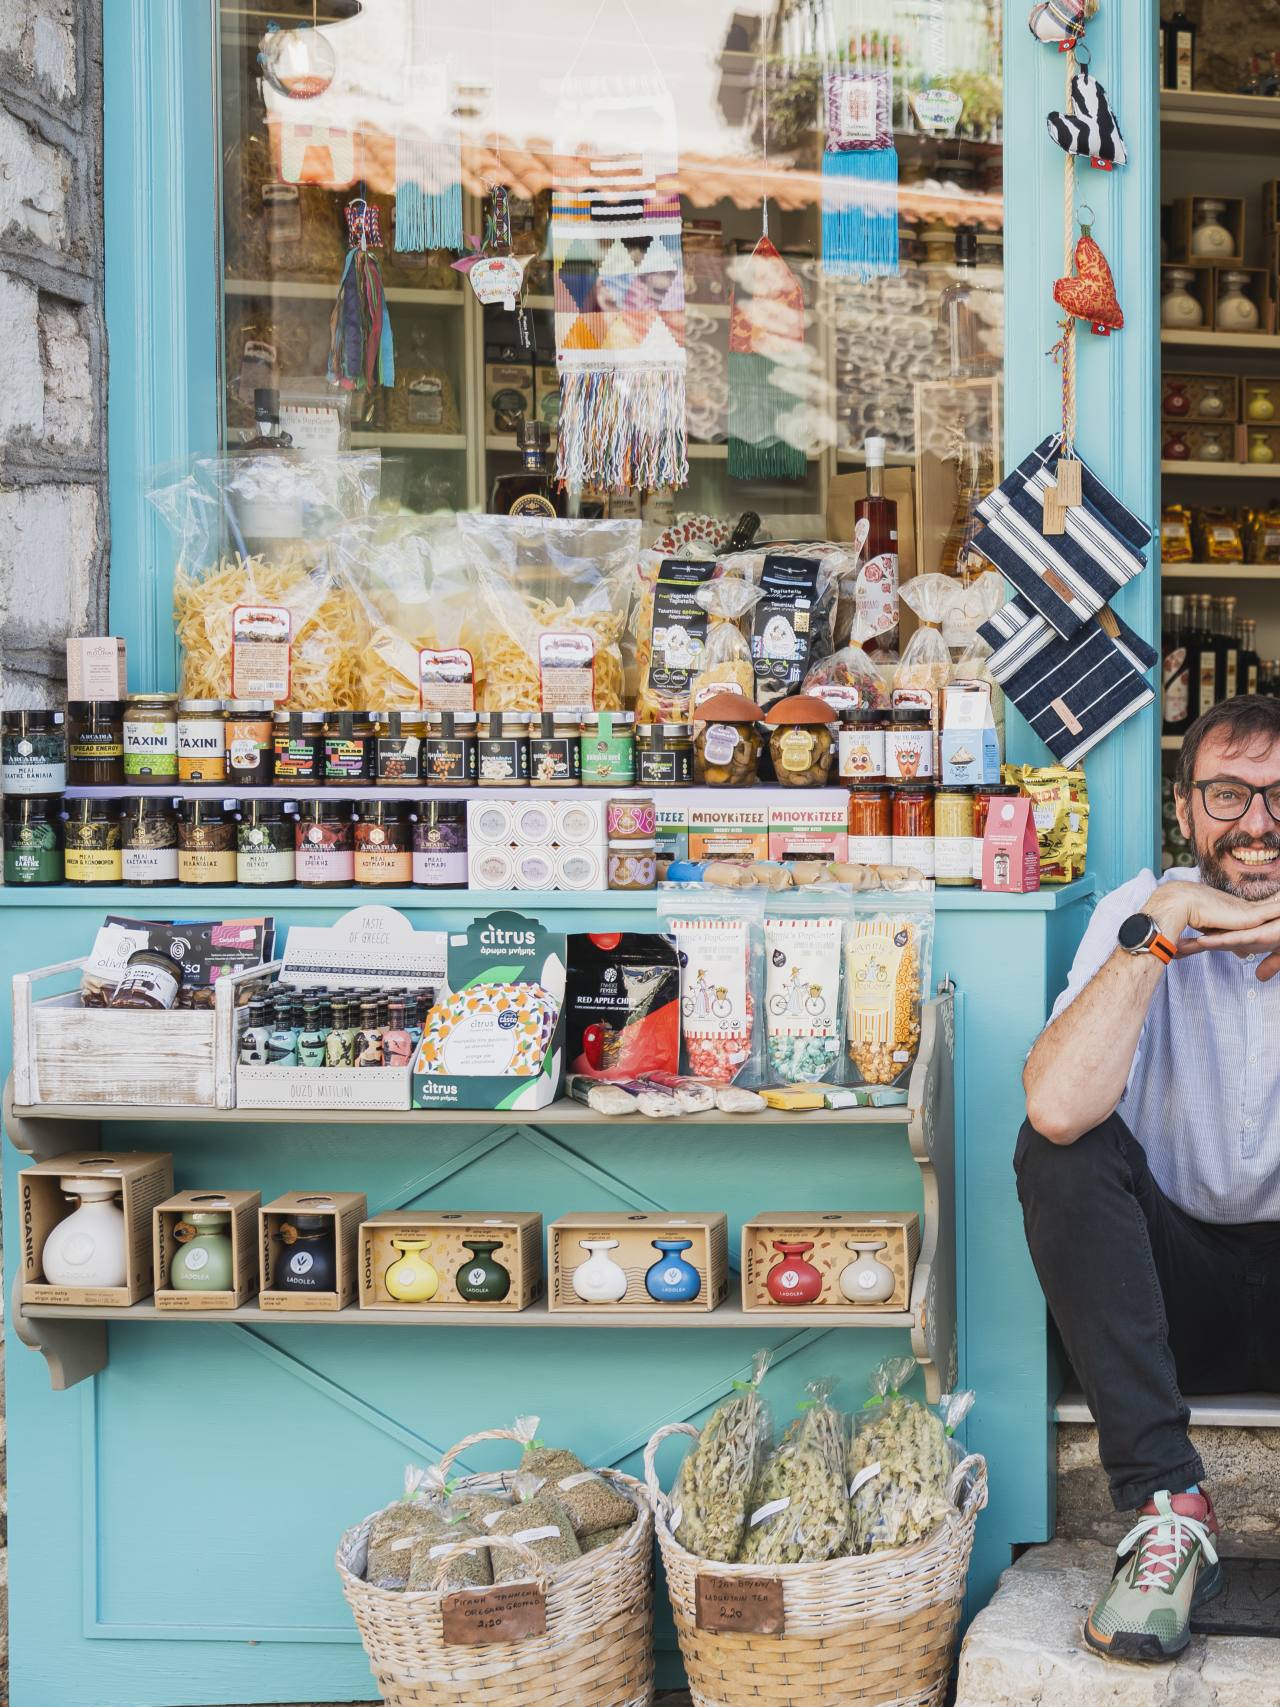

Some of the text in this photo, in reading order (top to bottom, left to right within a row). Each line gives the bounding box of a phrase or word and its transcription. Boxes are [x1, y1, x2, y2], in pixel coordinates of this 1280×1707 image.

[127, 736, 168, 746] TAXINI
[179, 736, 218, 746] TAXINI
[362, 918, 384, 931] TASTE
[349, 931, 392, 945] OF GREECE
[480, 924, 536, 945] citrus
[480, 946, 536, 957] άρωμα μνήμης
[594, 996, 616, 1004] APPLE
[290, 1084, 313, 1098] OUZO
[422, 1080, 458, 1095] citrus
[24, 1185, 34, 1269] ORGANIC
[286, 1276, 316, 1286] LADOLEA
